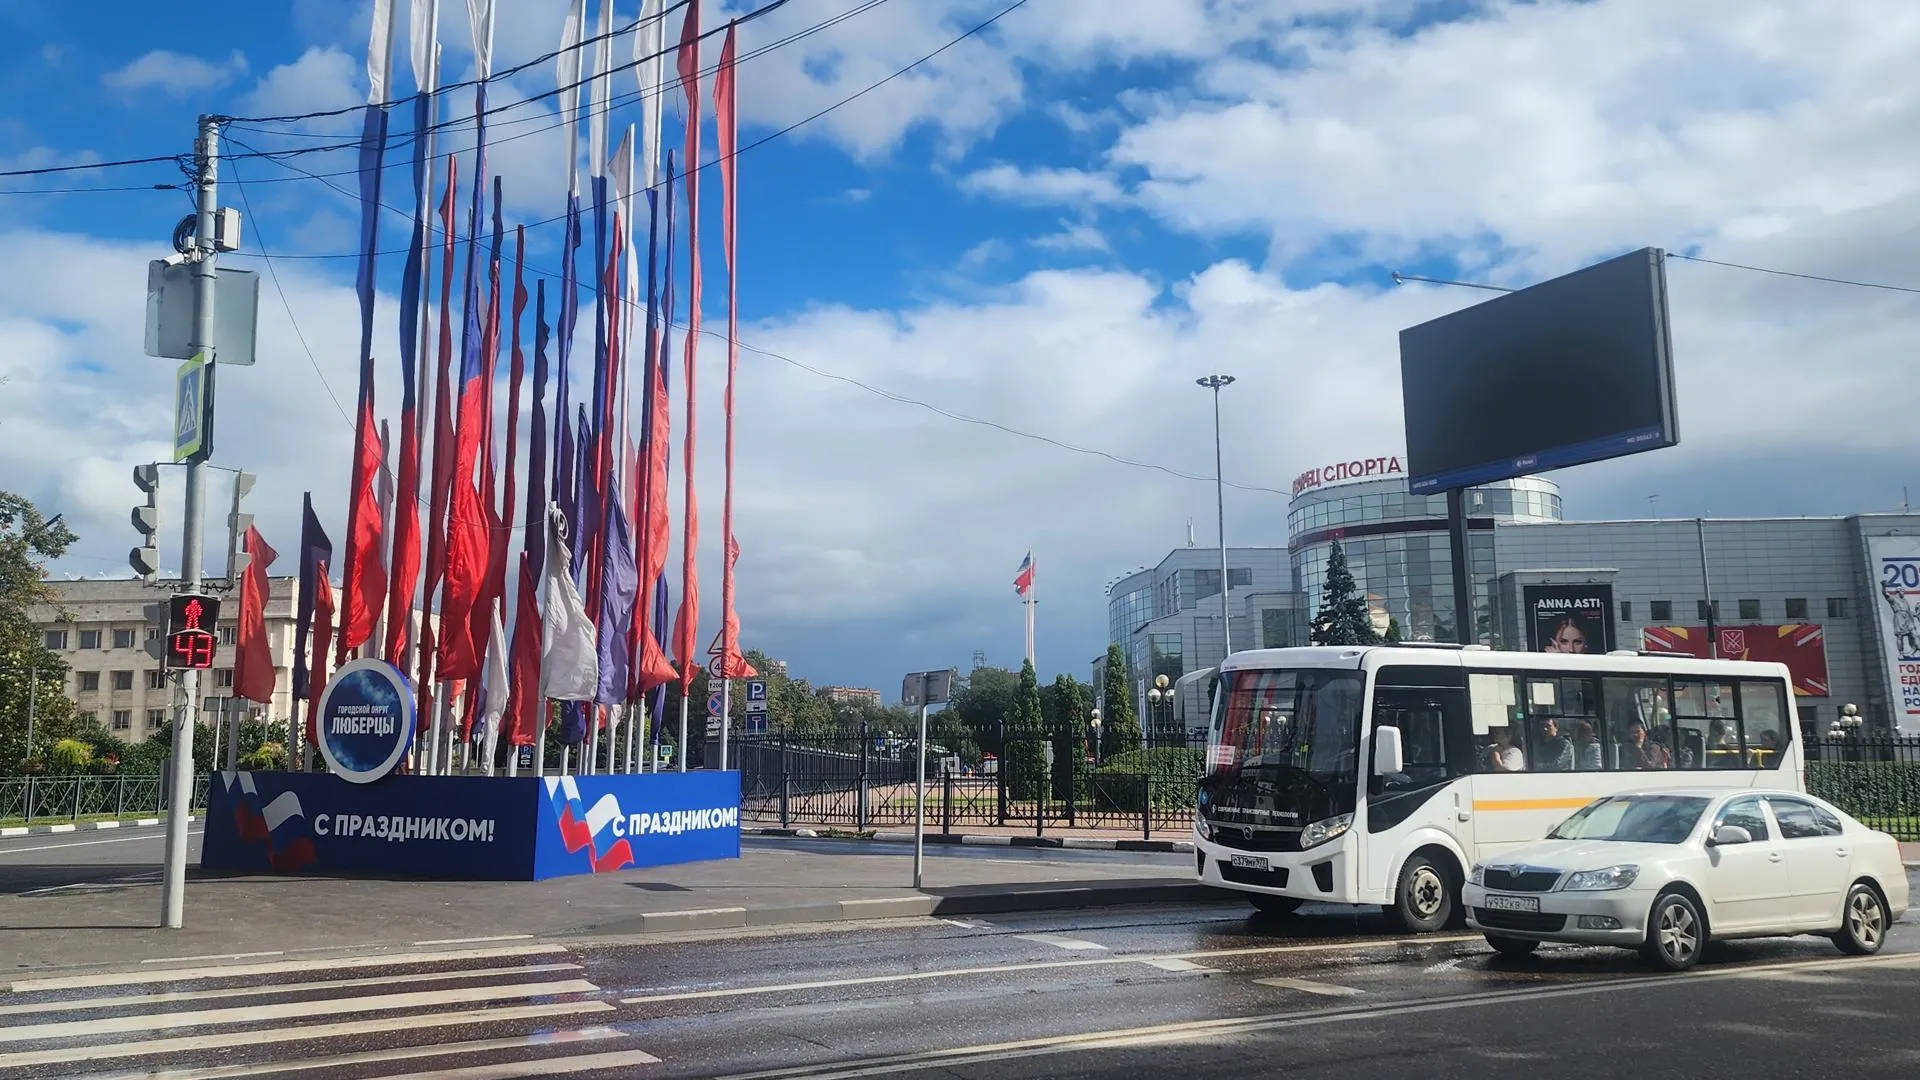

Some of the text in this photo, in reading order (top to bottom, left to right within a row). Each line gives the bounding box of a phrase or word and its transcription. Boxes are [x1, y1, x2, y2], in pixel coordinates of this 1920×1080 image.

[1323, 456, 1402, 482] СПОРТА
[1883, 563, 1920, 588] 20
[1537, 598, 1601, 609] ANNA ASTI
[175, 634, 213, 667] 43
[1900, 675, 1920, 686] ЕД
[337, 704, 389, 715] ГОРОДСКОЙ ОКРУГ
[331, 716, 395, 737] ЛЮБЕРЦЫ
[314, 813, 496, 842] С ПРАЗДНИКОМ!
[612, 806, 738, 837] С ПРАЗДНИКОМ!
